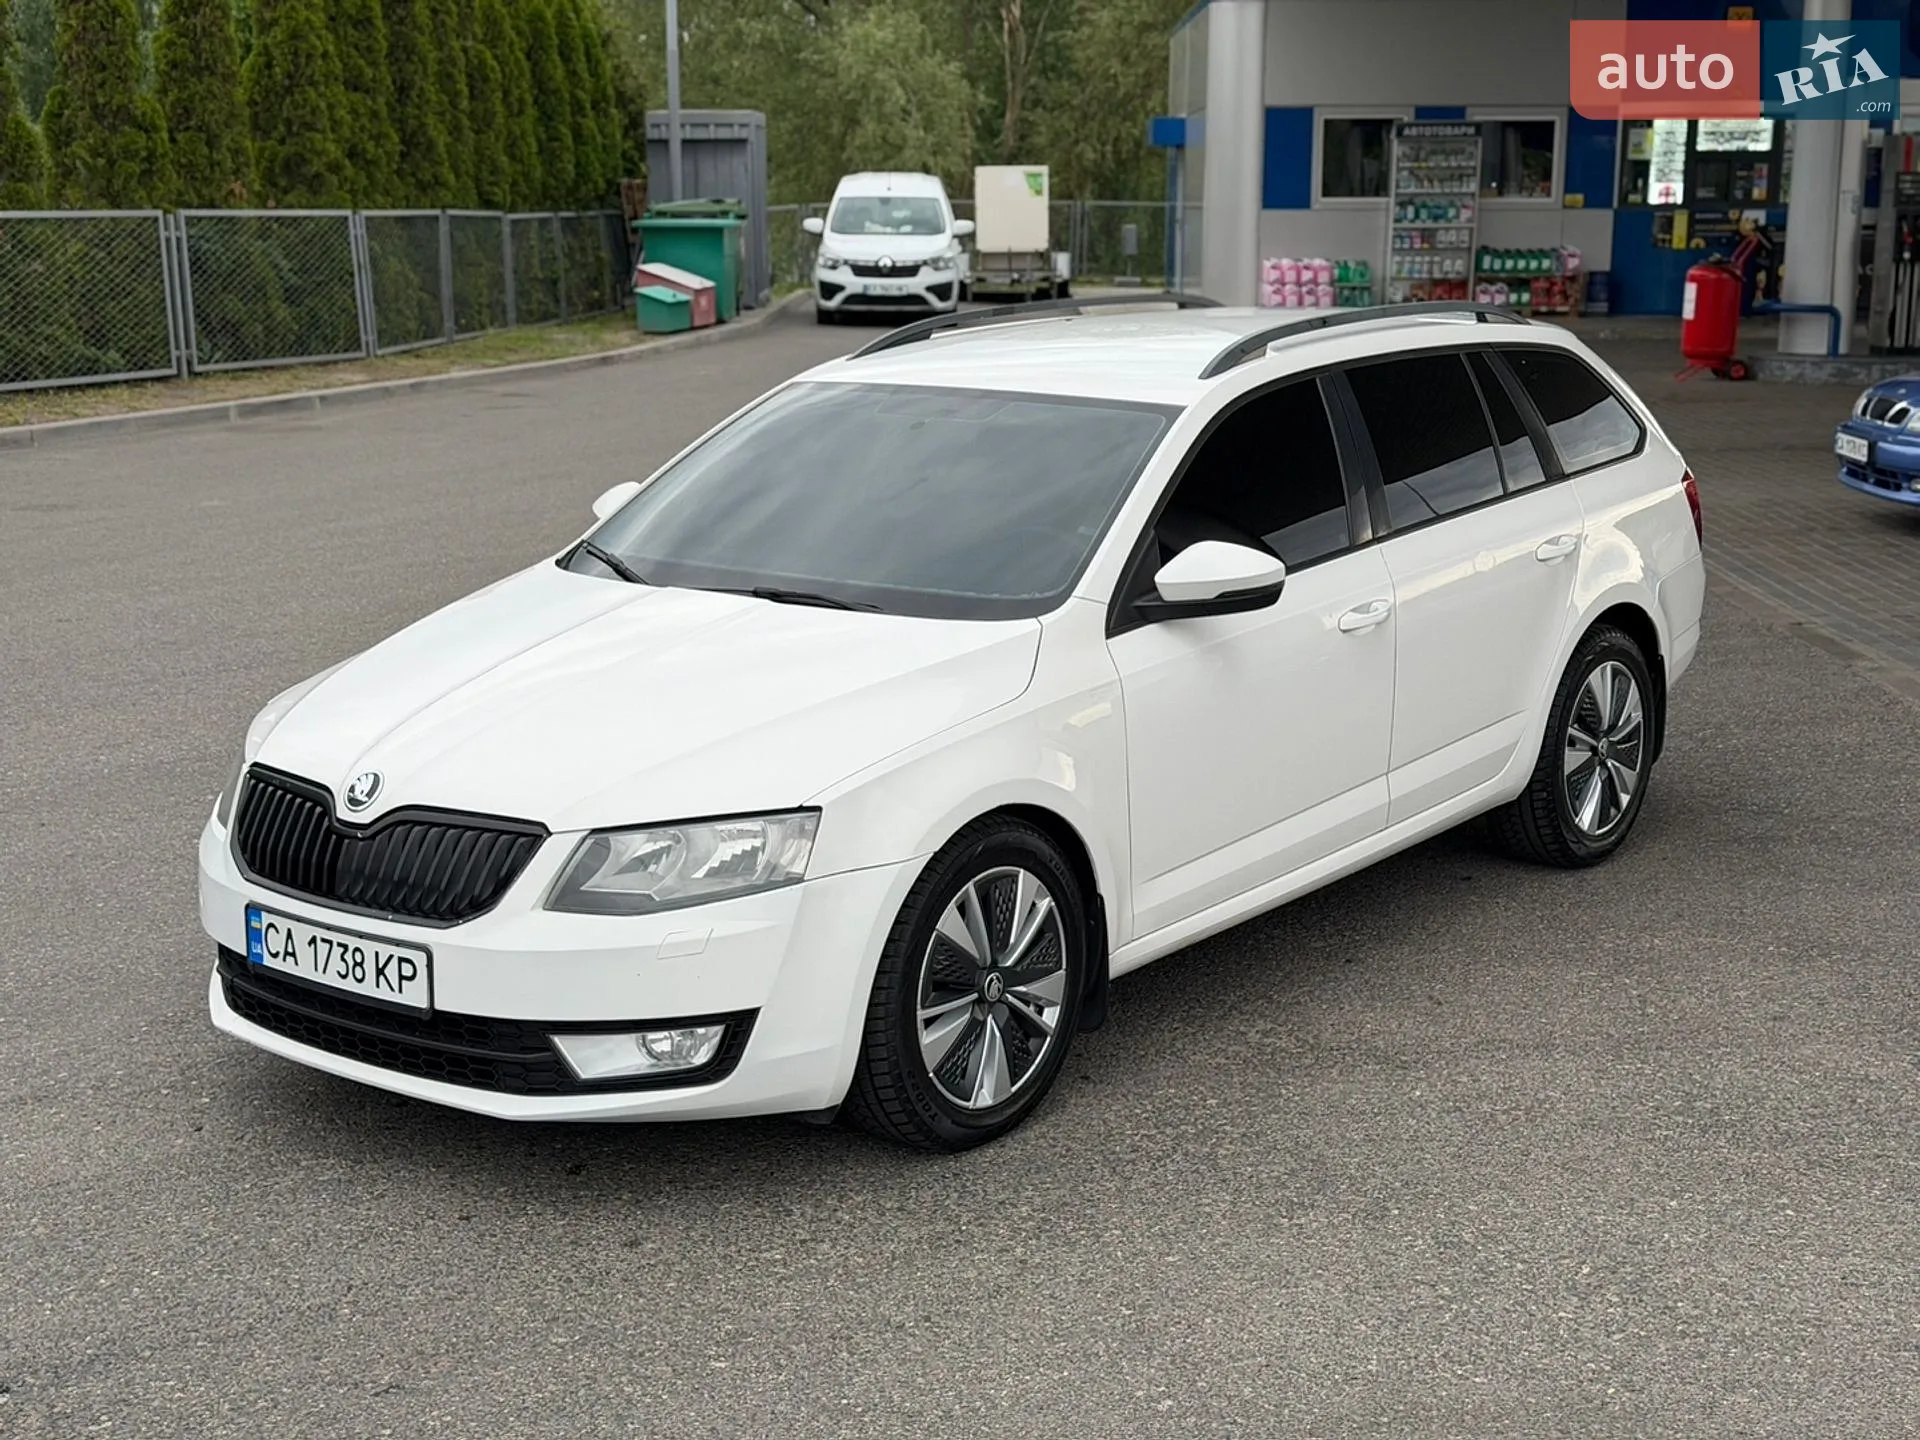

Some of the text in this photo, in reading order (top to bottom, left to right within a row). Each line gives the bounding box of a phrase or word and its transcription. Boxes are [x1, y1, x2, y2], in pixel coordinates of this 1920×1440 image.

[252, 941, 263, 954] UA
[264, 922, 418, 995] CA 1738 KP
